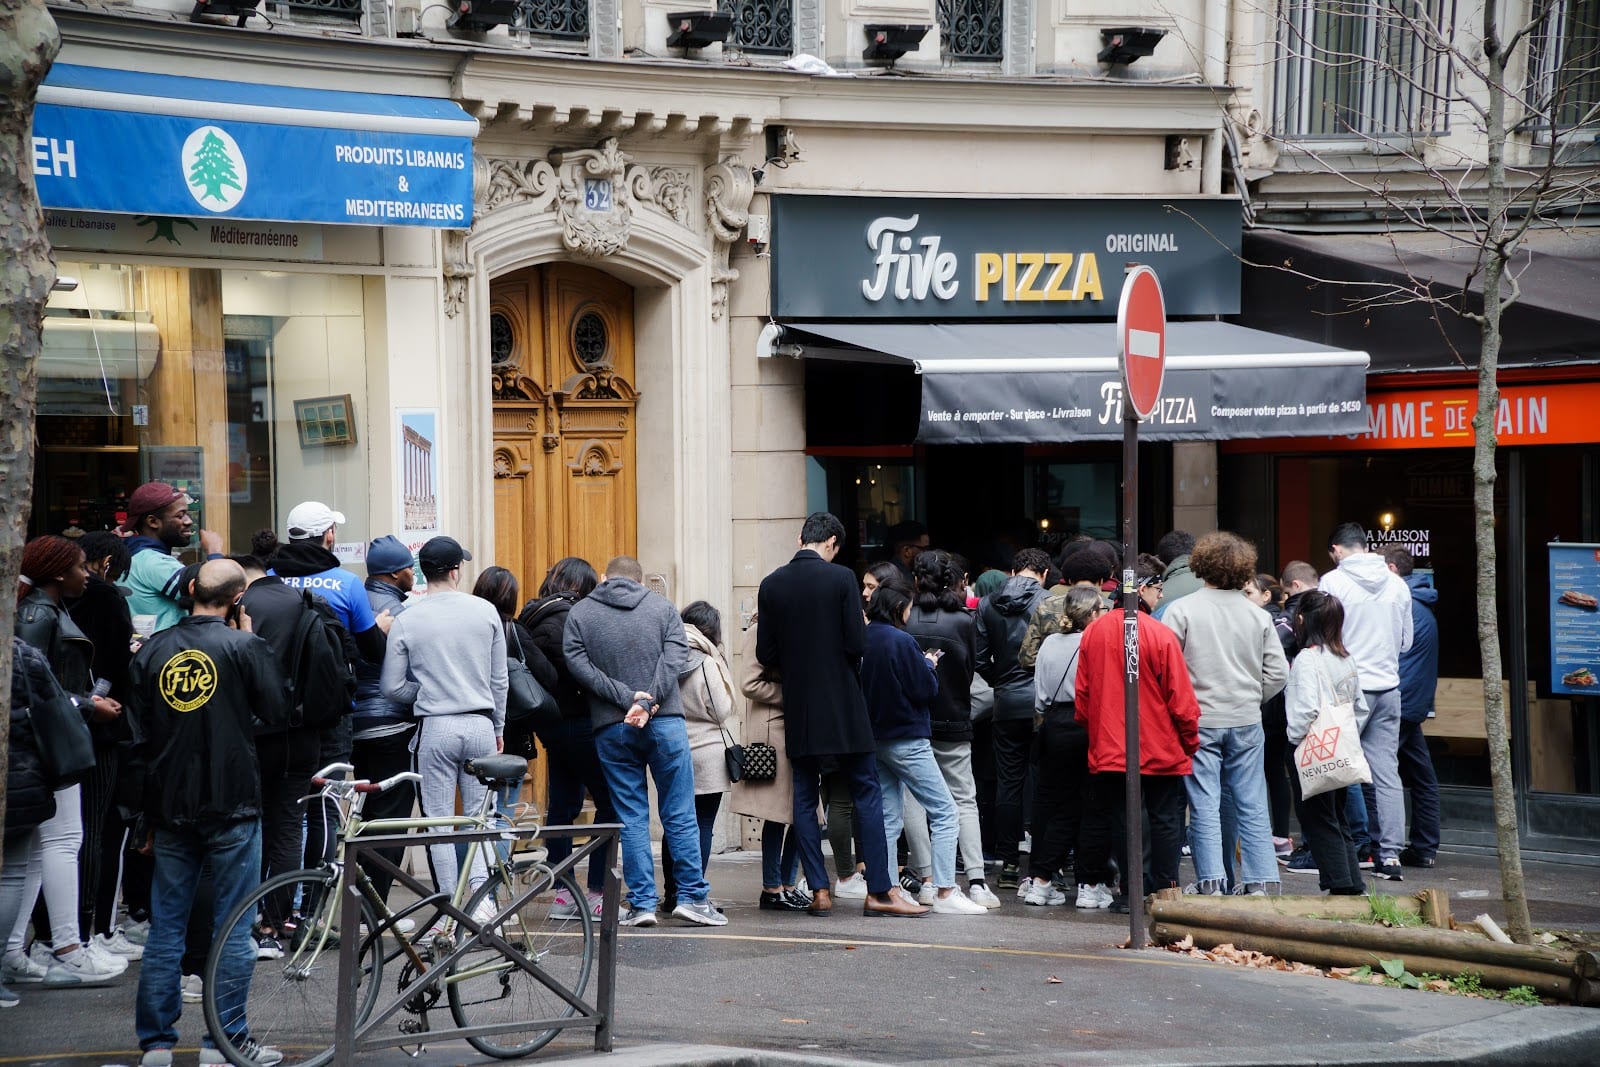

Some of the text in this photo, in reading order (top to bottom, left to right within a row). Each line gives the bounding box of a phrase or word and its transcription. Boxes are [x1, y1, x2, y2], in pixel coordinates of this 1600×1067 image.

[32, 137, 77, 178] EH
[335, 145, 465, 170] PRODUITS LIBANAIS
[398, 175, 409, 192] &
[345, 199, 464, 220] MEDITERRANEENS
[46, 216, 116, 230] alité Libanaise
[210, 225, 298, 248] Méditerranéenne
[1106, 233, 1178, 253] ORIGINAL
[862, 213, 1104, 302] Five PIZZA
[927, 410, 952, 422] Vente
[953, 409, 961, 421] à
[963, 409, 1005, 424] emporter
[1010, 409, 1023, 420] Sur
[1024, 408, 1046, 422] place
[1053, 407, 1092, 419] Livraison
[1150, 397, 1197, 425] PIZZA
[1211, 405, 1252, 419] Composer
[1254, 405, 1276, 416] votre
[1277, 404, 1297, 418] pizza
[1299, 404, 1305, 415] à
[1306, 402, 1327, 417] partir
[1329, 402, 1339, 413] de
[1445, 406, 1467, 430] DE
[1496, 396, 1548, 436] AIN
[1378, 529, 1430, 542] MAISON
[303, 576, 342, 591] BOCK
[164, 663, 214, 696] Five
[1301, 757, 1351, 779] NEW3DGE
